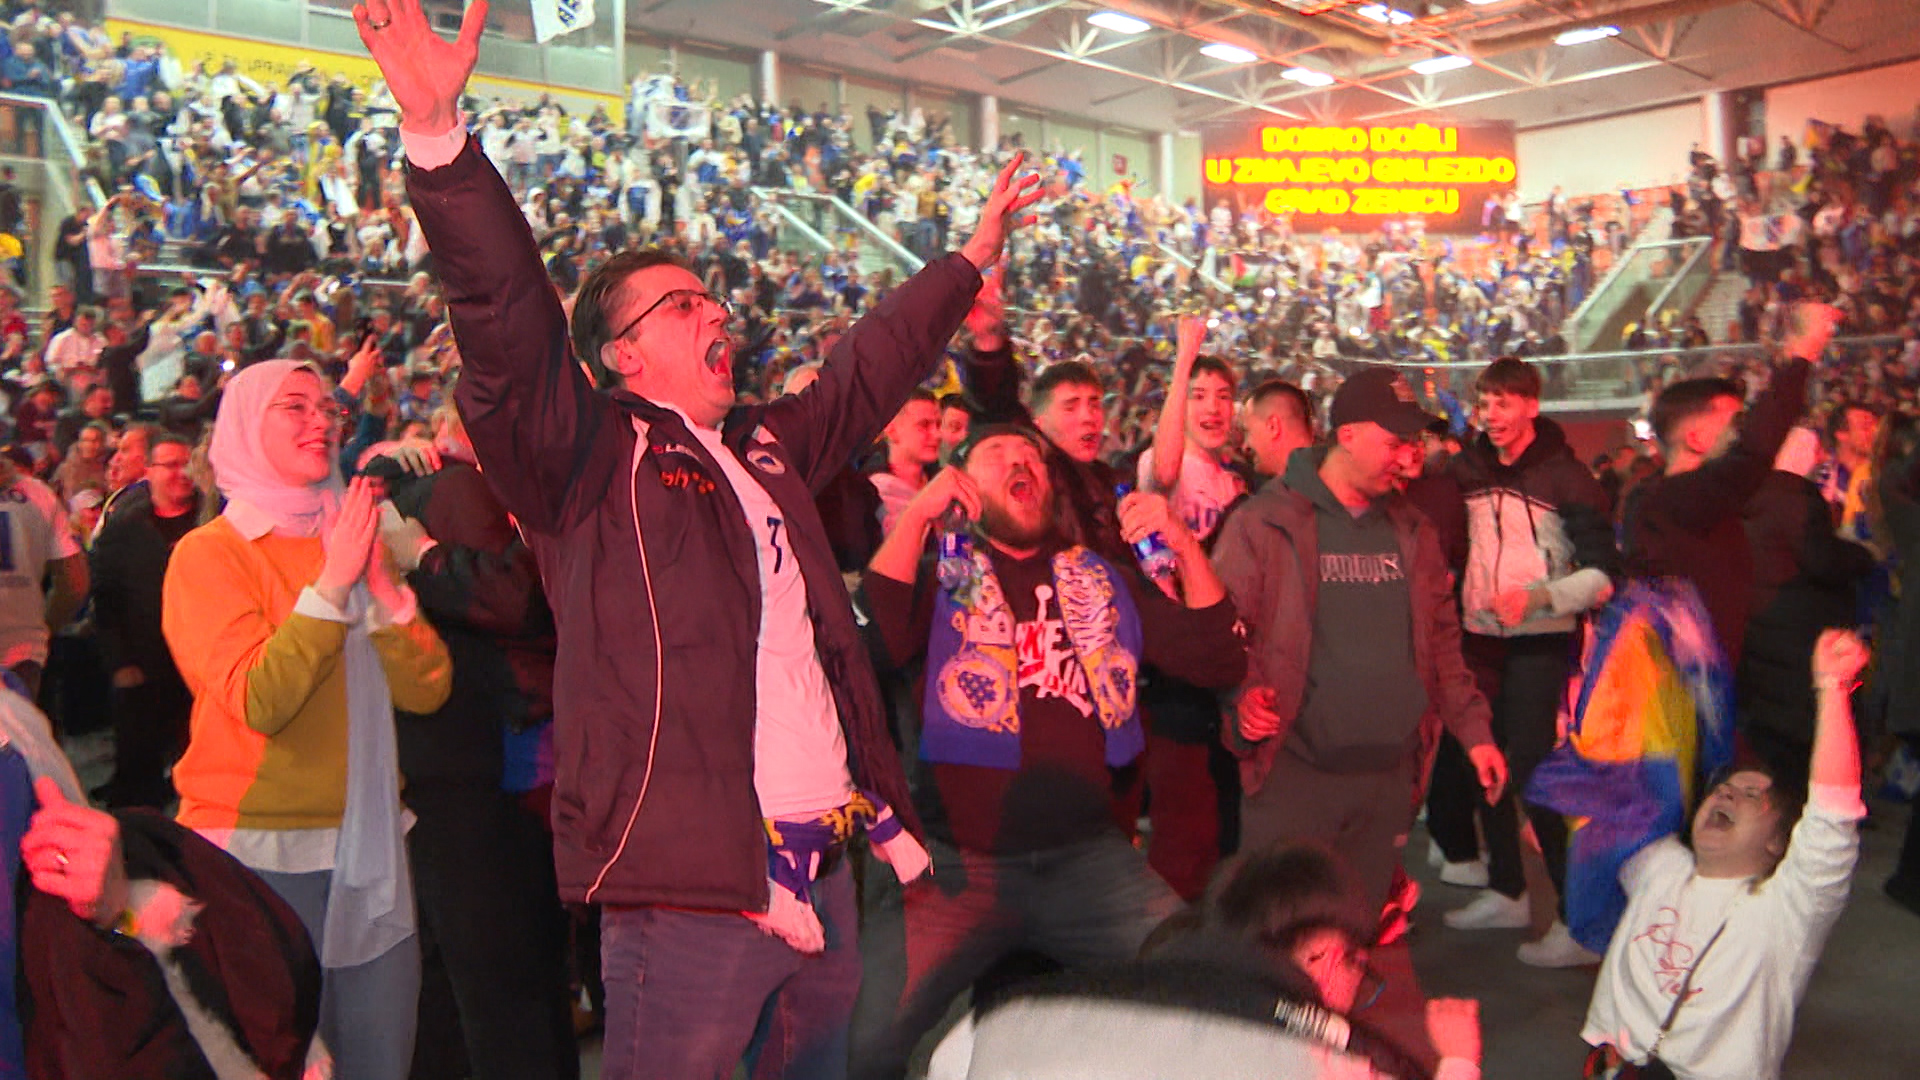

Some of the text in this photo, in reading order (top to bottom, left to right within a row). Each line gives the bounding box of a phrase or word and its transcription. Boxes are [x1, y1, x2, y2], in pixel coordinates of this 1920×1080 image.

[1262, 123, 1457, 152] DOBRO DOŠLI
[1205, 158, 1232, 184] U
[1233, 157, 1370, 184] ZMAJEVO
[1264, 187, 1459, 214] GRAD ZENICU
[766, 516, 783, 574] 7
